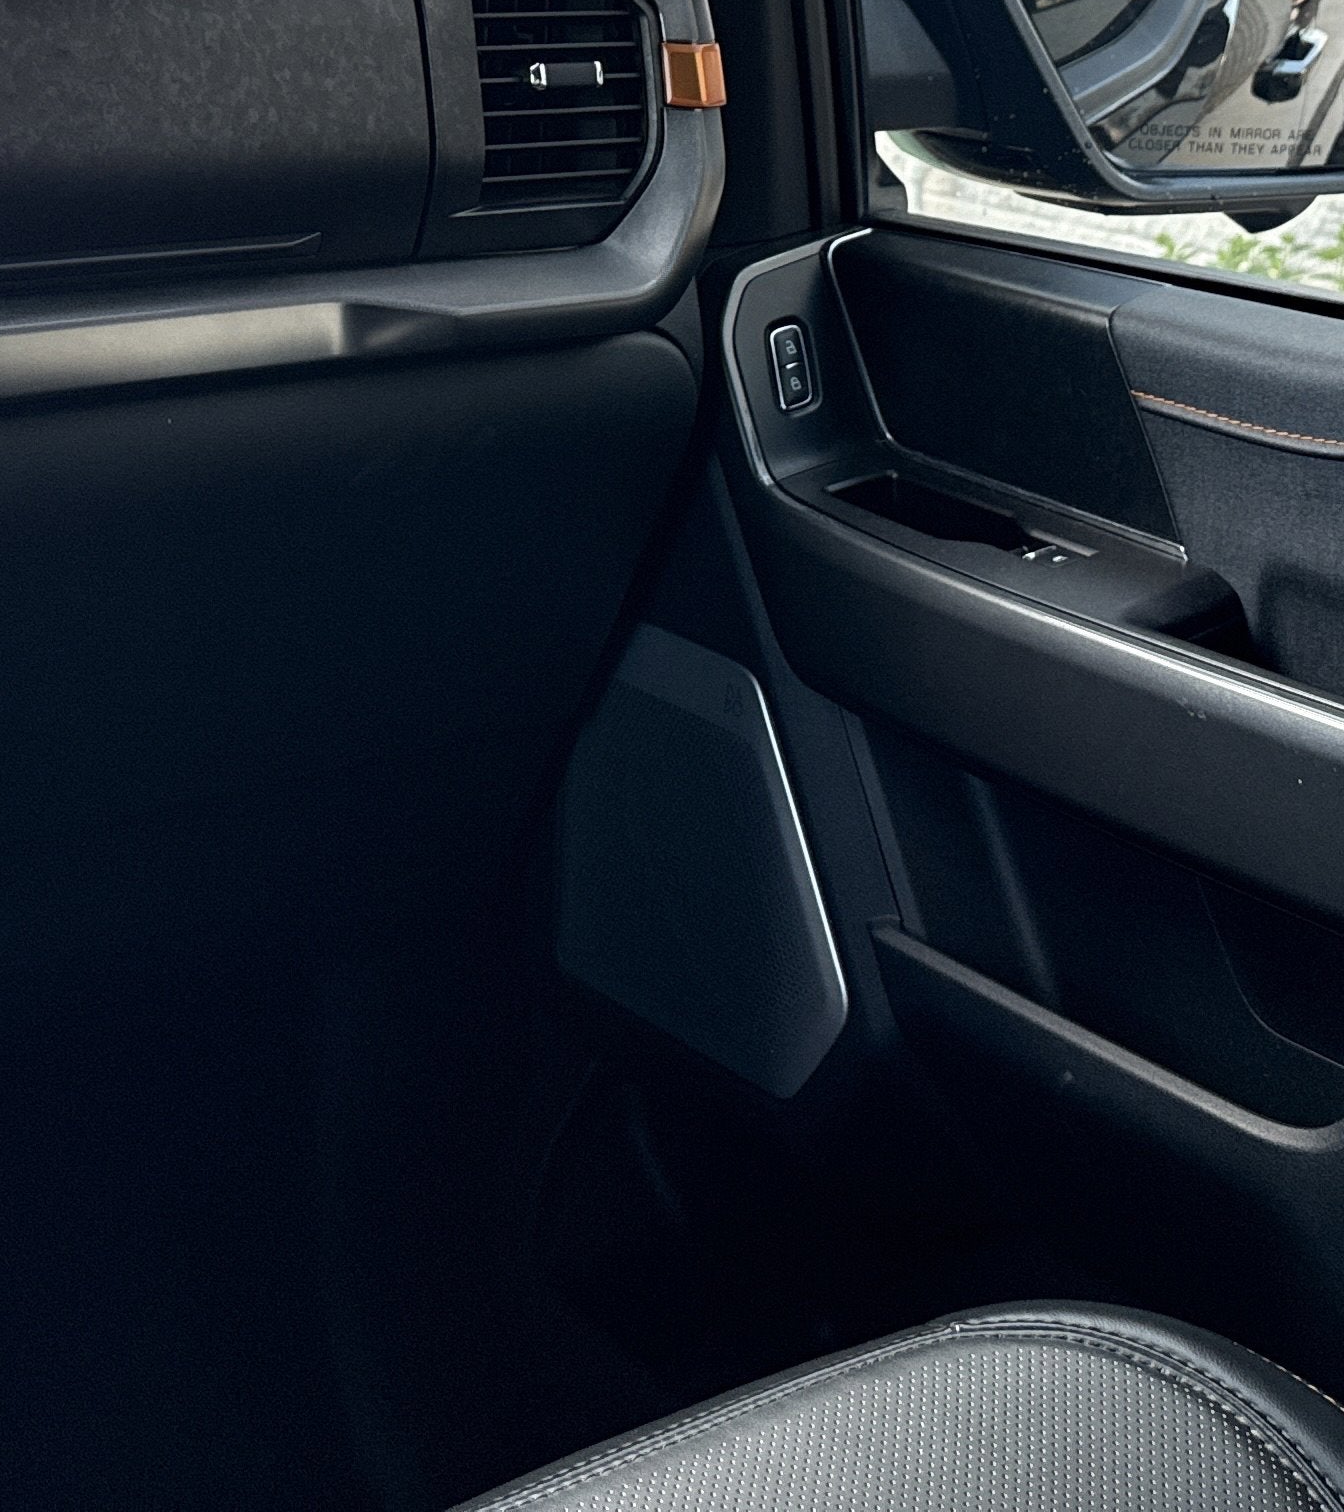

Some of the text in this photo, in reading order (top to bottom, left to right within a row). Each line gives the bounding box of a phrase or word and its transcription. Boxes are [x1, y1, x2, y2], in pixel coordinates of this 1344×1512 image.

[1139, 124, 1200, 137] OBJECTS
[1208, 126, 1222, 138] IN
[1230, 127, 1281, 140] MIRROR
[1128, 139, 1322, 156] CLOSER THAN THEY APPEAR
